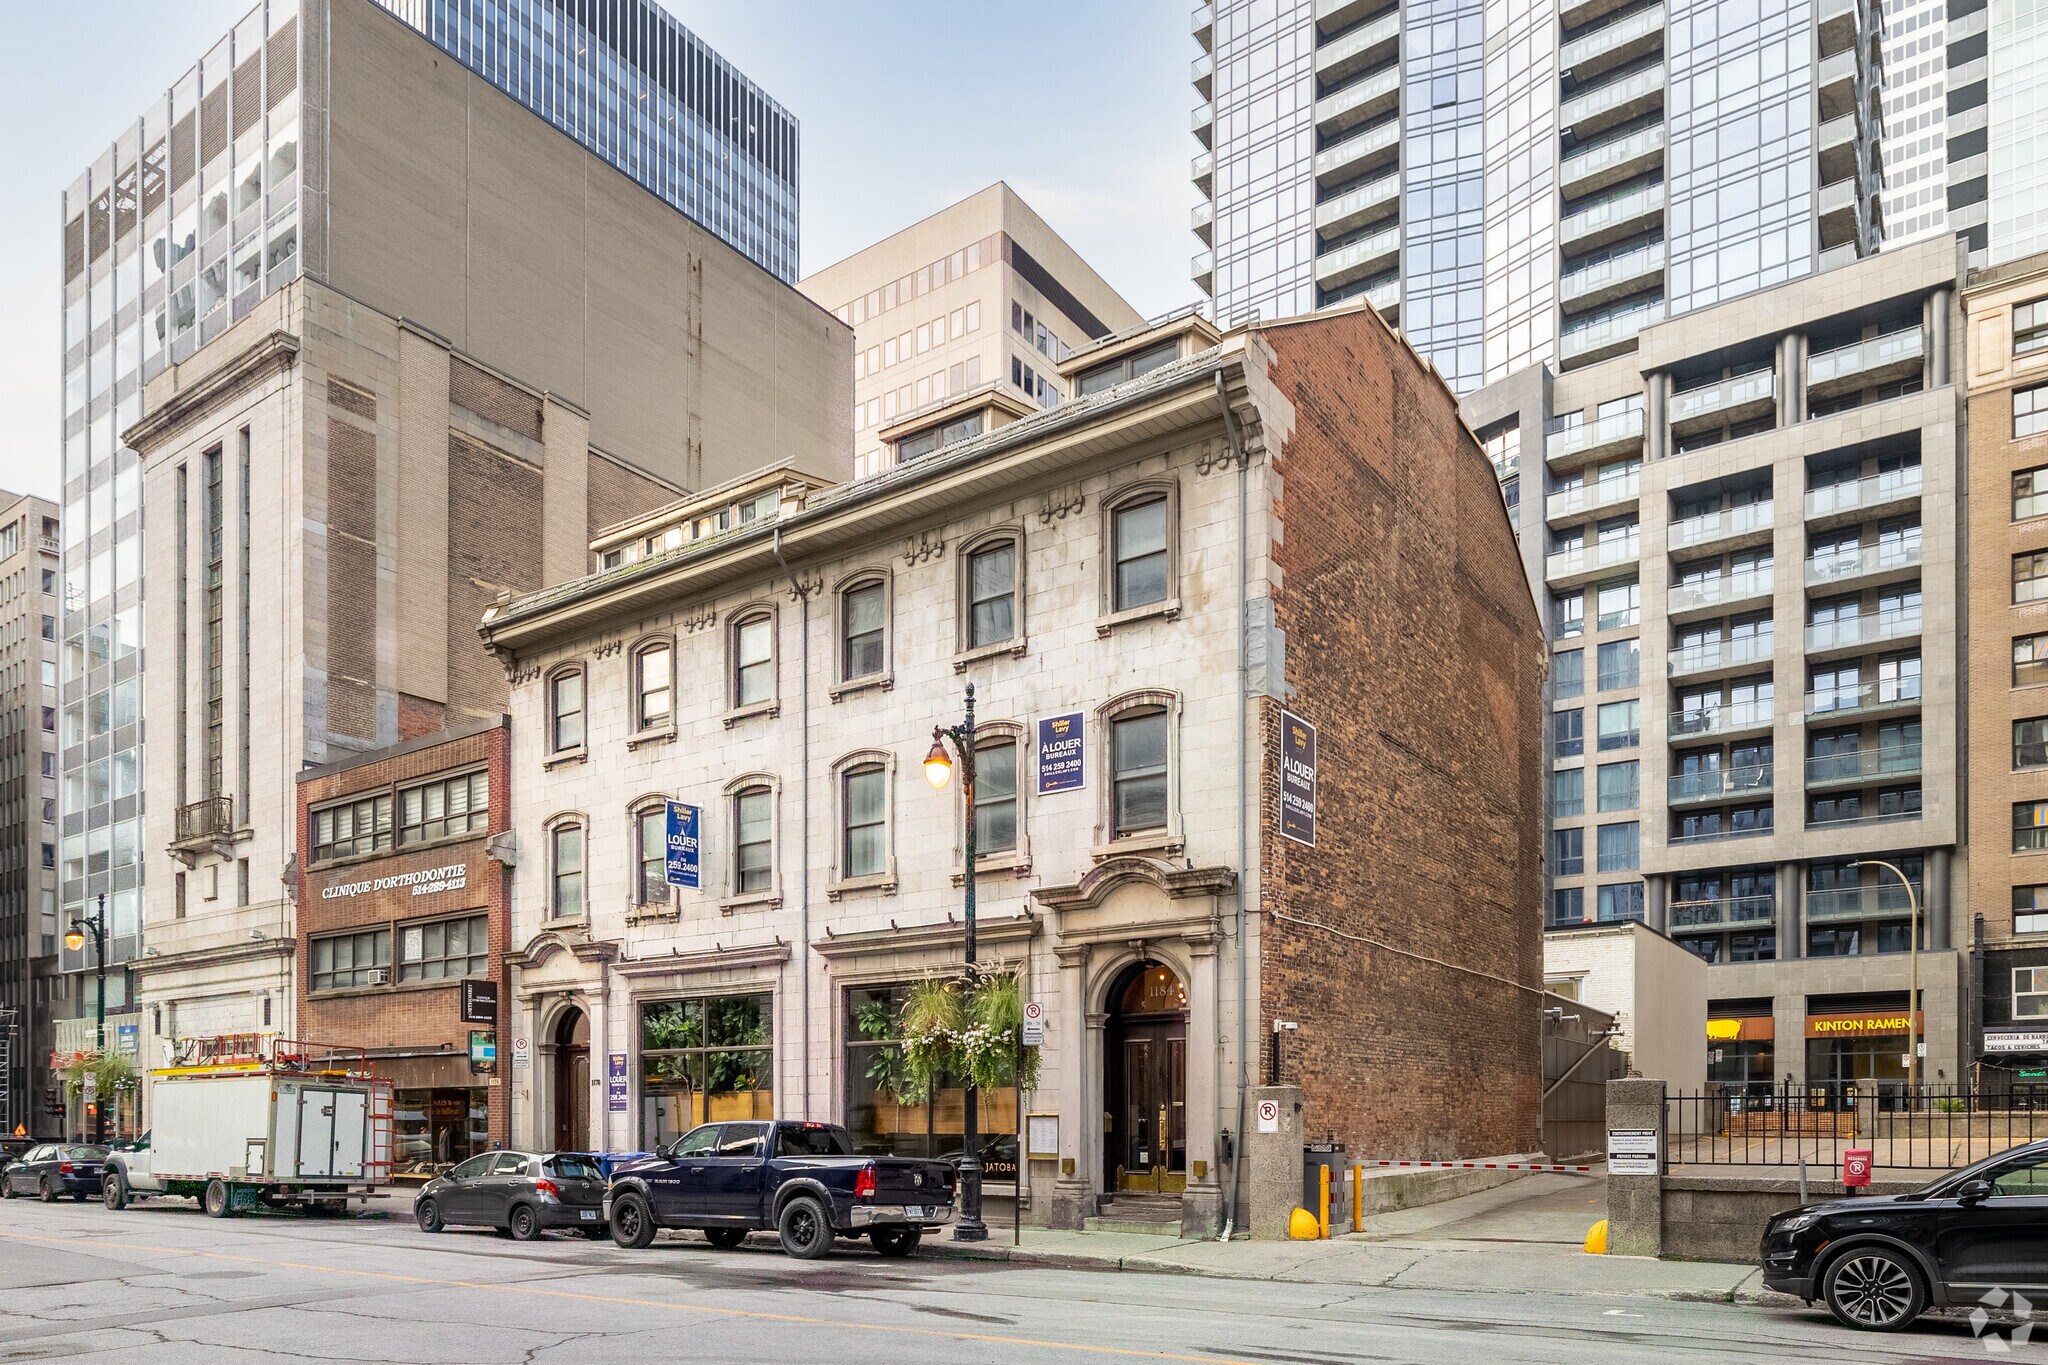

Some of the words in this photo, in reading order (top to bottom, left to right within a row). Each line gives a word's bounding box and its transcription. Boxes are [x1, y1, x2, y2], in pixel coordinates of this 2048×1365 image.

[1051, 719, 1070, 728] Shiller
[1042, 742, 1049, 754] À
[1050, 738, 1081, 753] LOUER
[1046, 749, 1077, 760] BUREAUX
[1041, 764, 1052, 773] 514
[1053, 761, 1065, 771] 259
[1066, 759, 1082, 768] 2400
[1283, 752, 1290, 770] À
[1290, 758, 1314, 782] LOUER
[1287, 772, 1310, 791] BUREAUX
[1283, 791, 1293, 803] 514
[1293, 793, 1301, 808] 259
[1302, 798, 1314, 813] 2400
[680, 827, 685, 836] À
[668, 834, 697, 848] LOUER
[671, 845, 694, 853] BUREAUX
[668, 860, 698, 873] 259.2400
[322, 881, 371, 899] CLINIQUE
[373, 864, 466, 891] D'ORTHODONTIE
[412, 878, 466, 896] 514-289-4113
[1815, 1019, 1863, 1032] KINTON
[1867, 1018, 1911, 1030] RAMEN
[985, 1162, 1016, 1173] JATOBA
